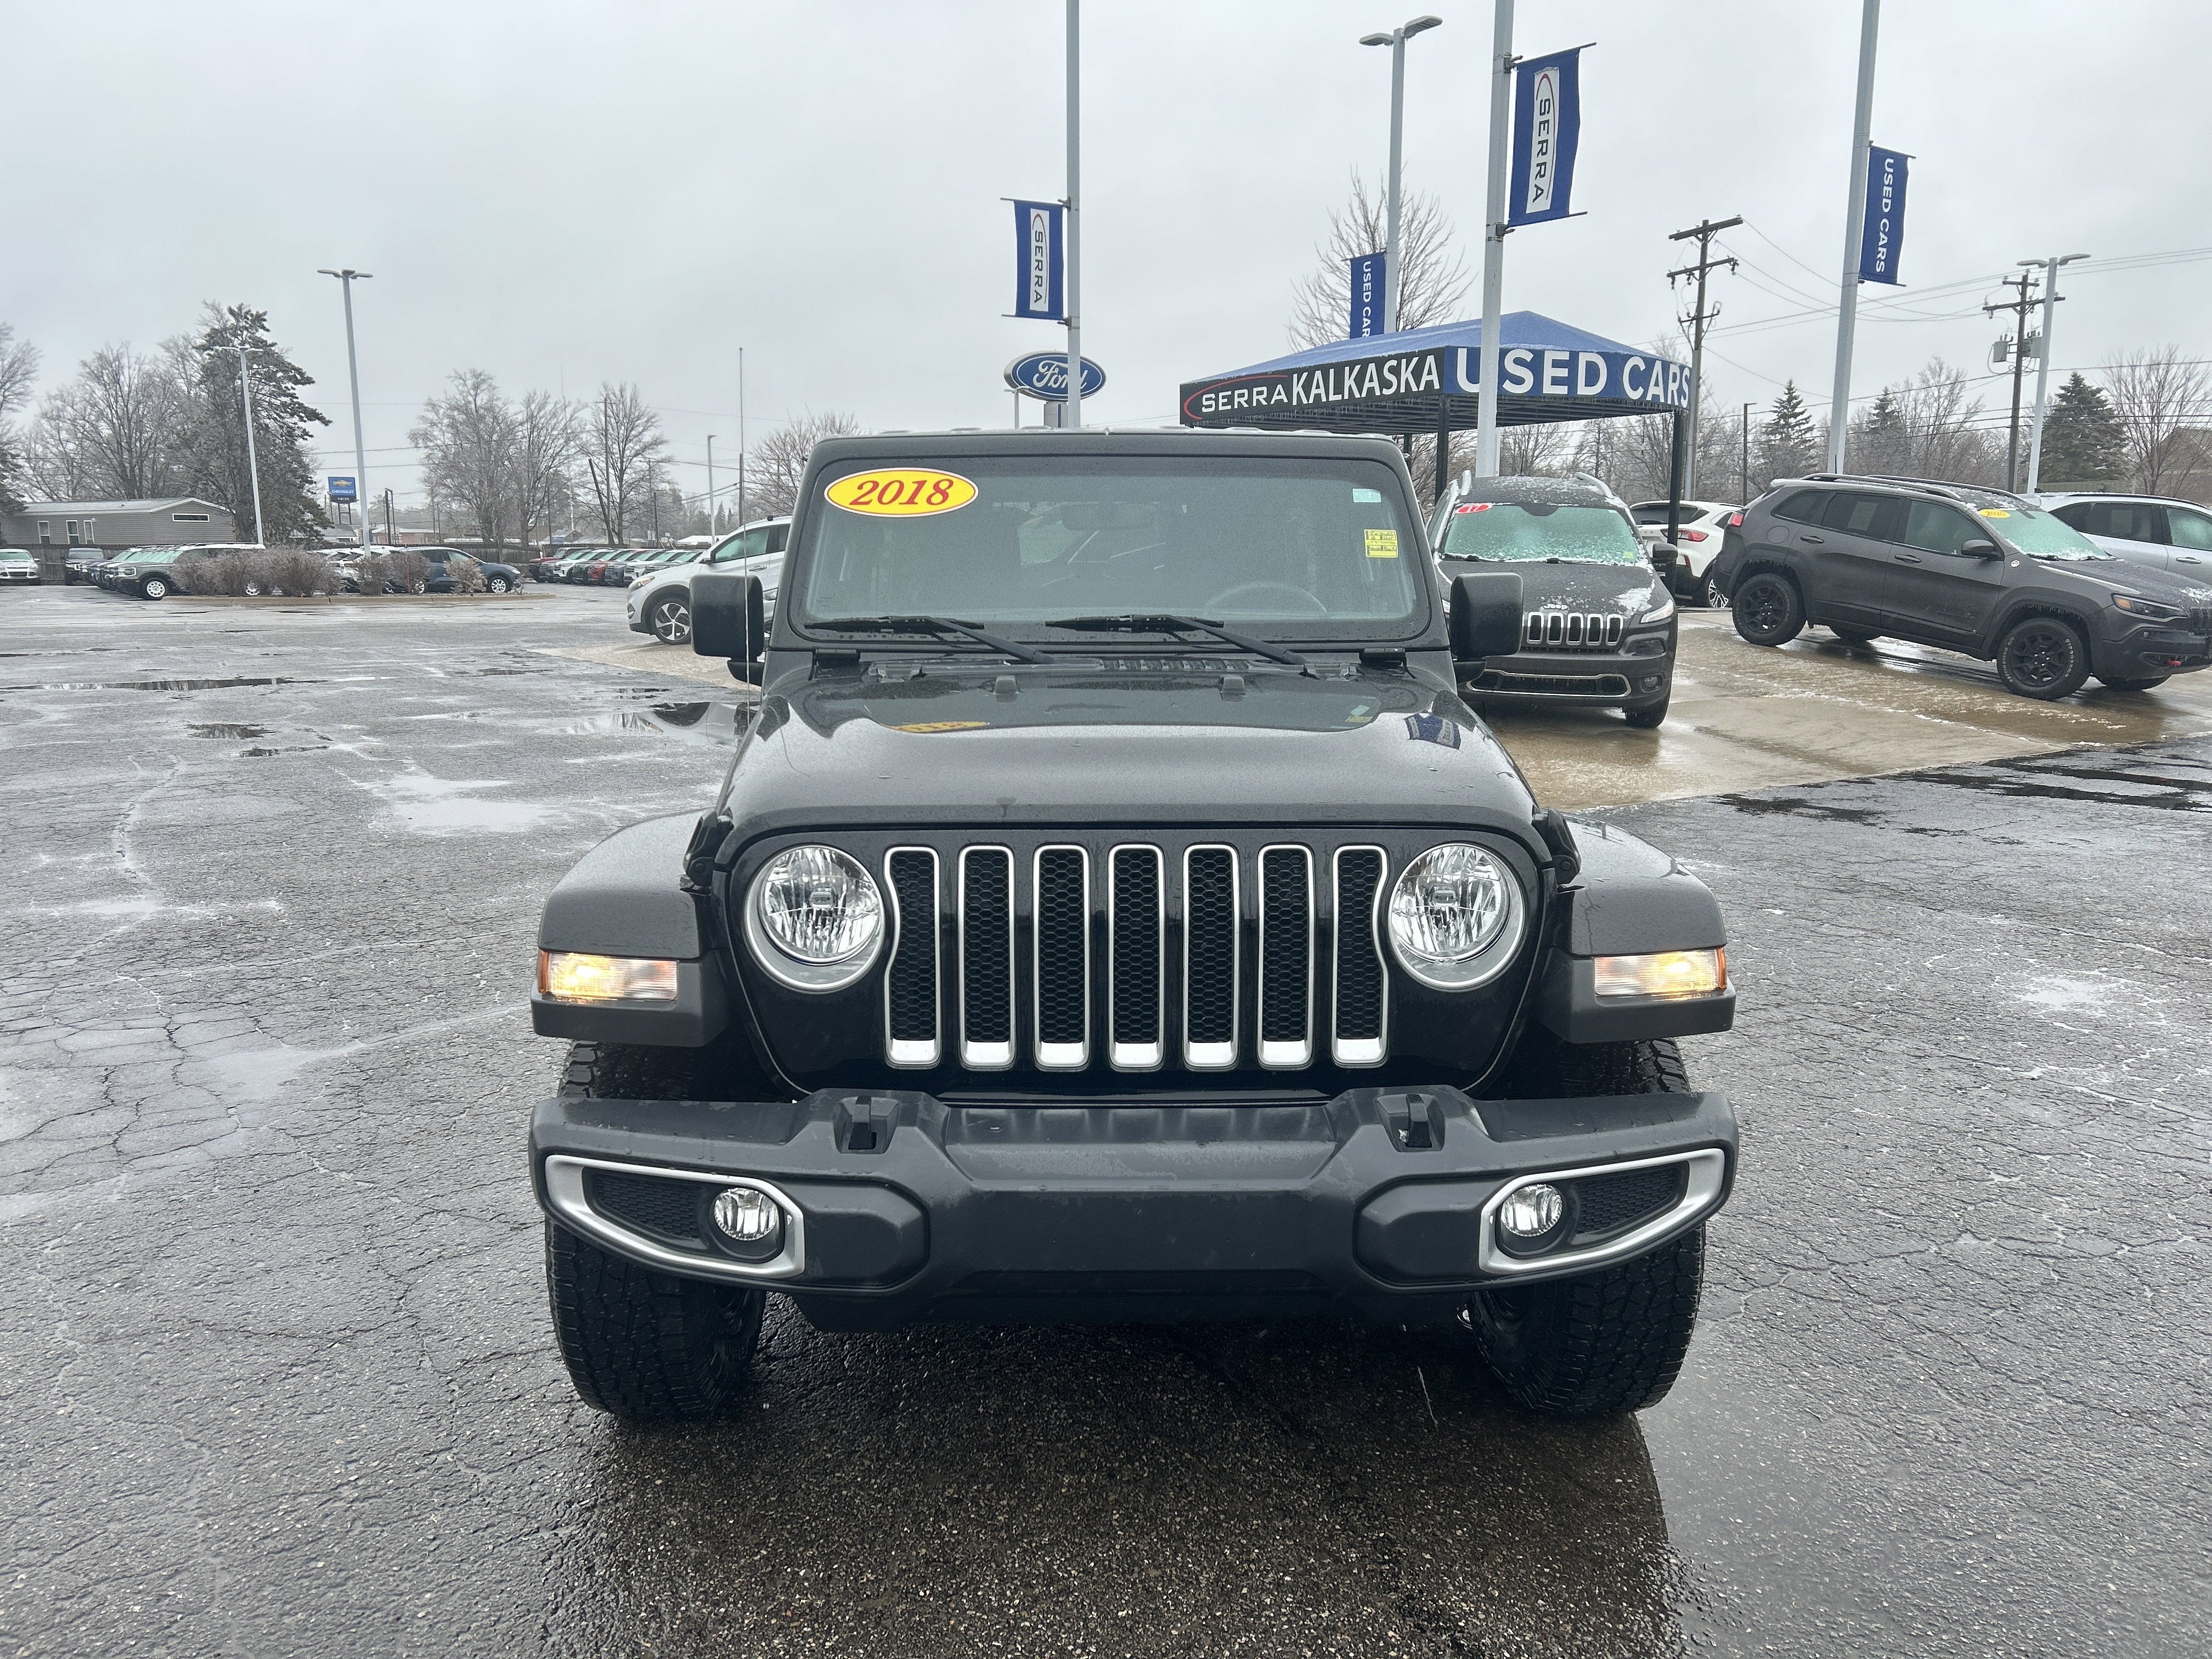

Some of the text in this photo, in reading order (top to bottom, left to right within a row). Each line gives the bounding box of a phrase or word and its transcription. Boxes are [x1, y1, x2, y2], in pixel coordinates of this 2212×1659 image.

[1532, 98, 1551, 203] SERRA
[1876, 157, 1894, 273] USED CARS
[1034, 229, 1043, 303] SERRA
[1362, 261, 1372, 337] USED CAR
[1201, 354, 1441, 413] SERRA KALKASKA
[1457, 347, 1690, 409] USED CARS
[849, 478, 954, 505] 2018
